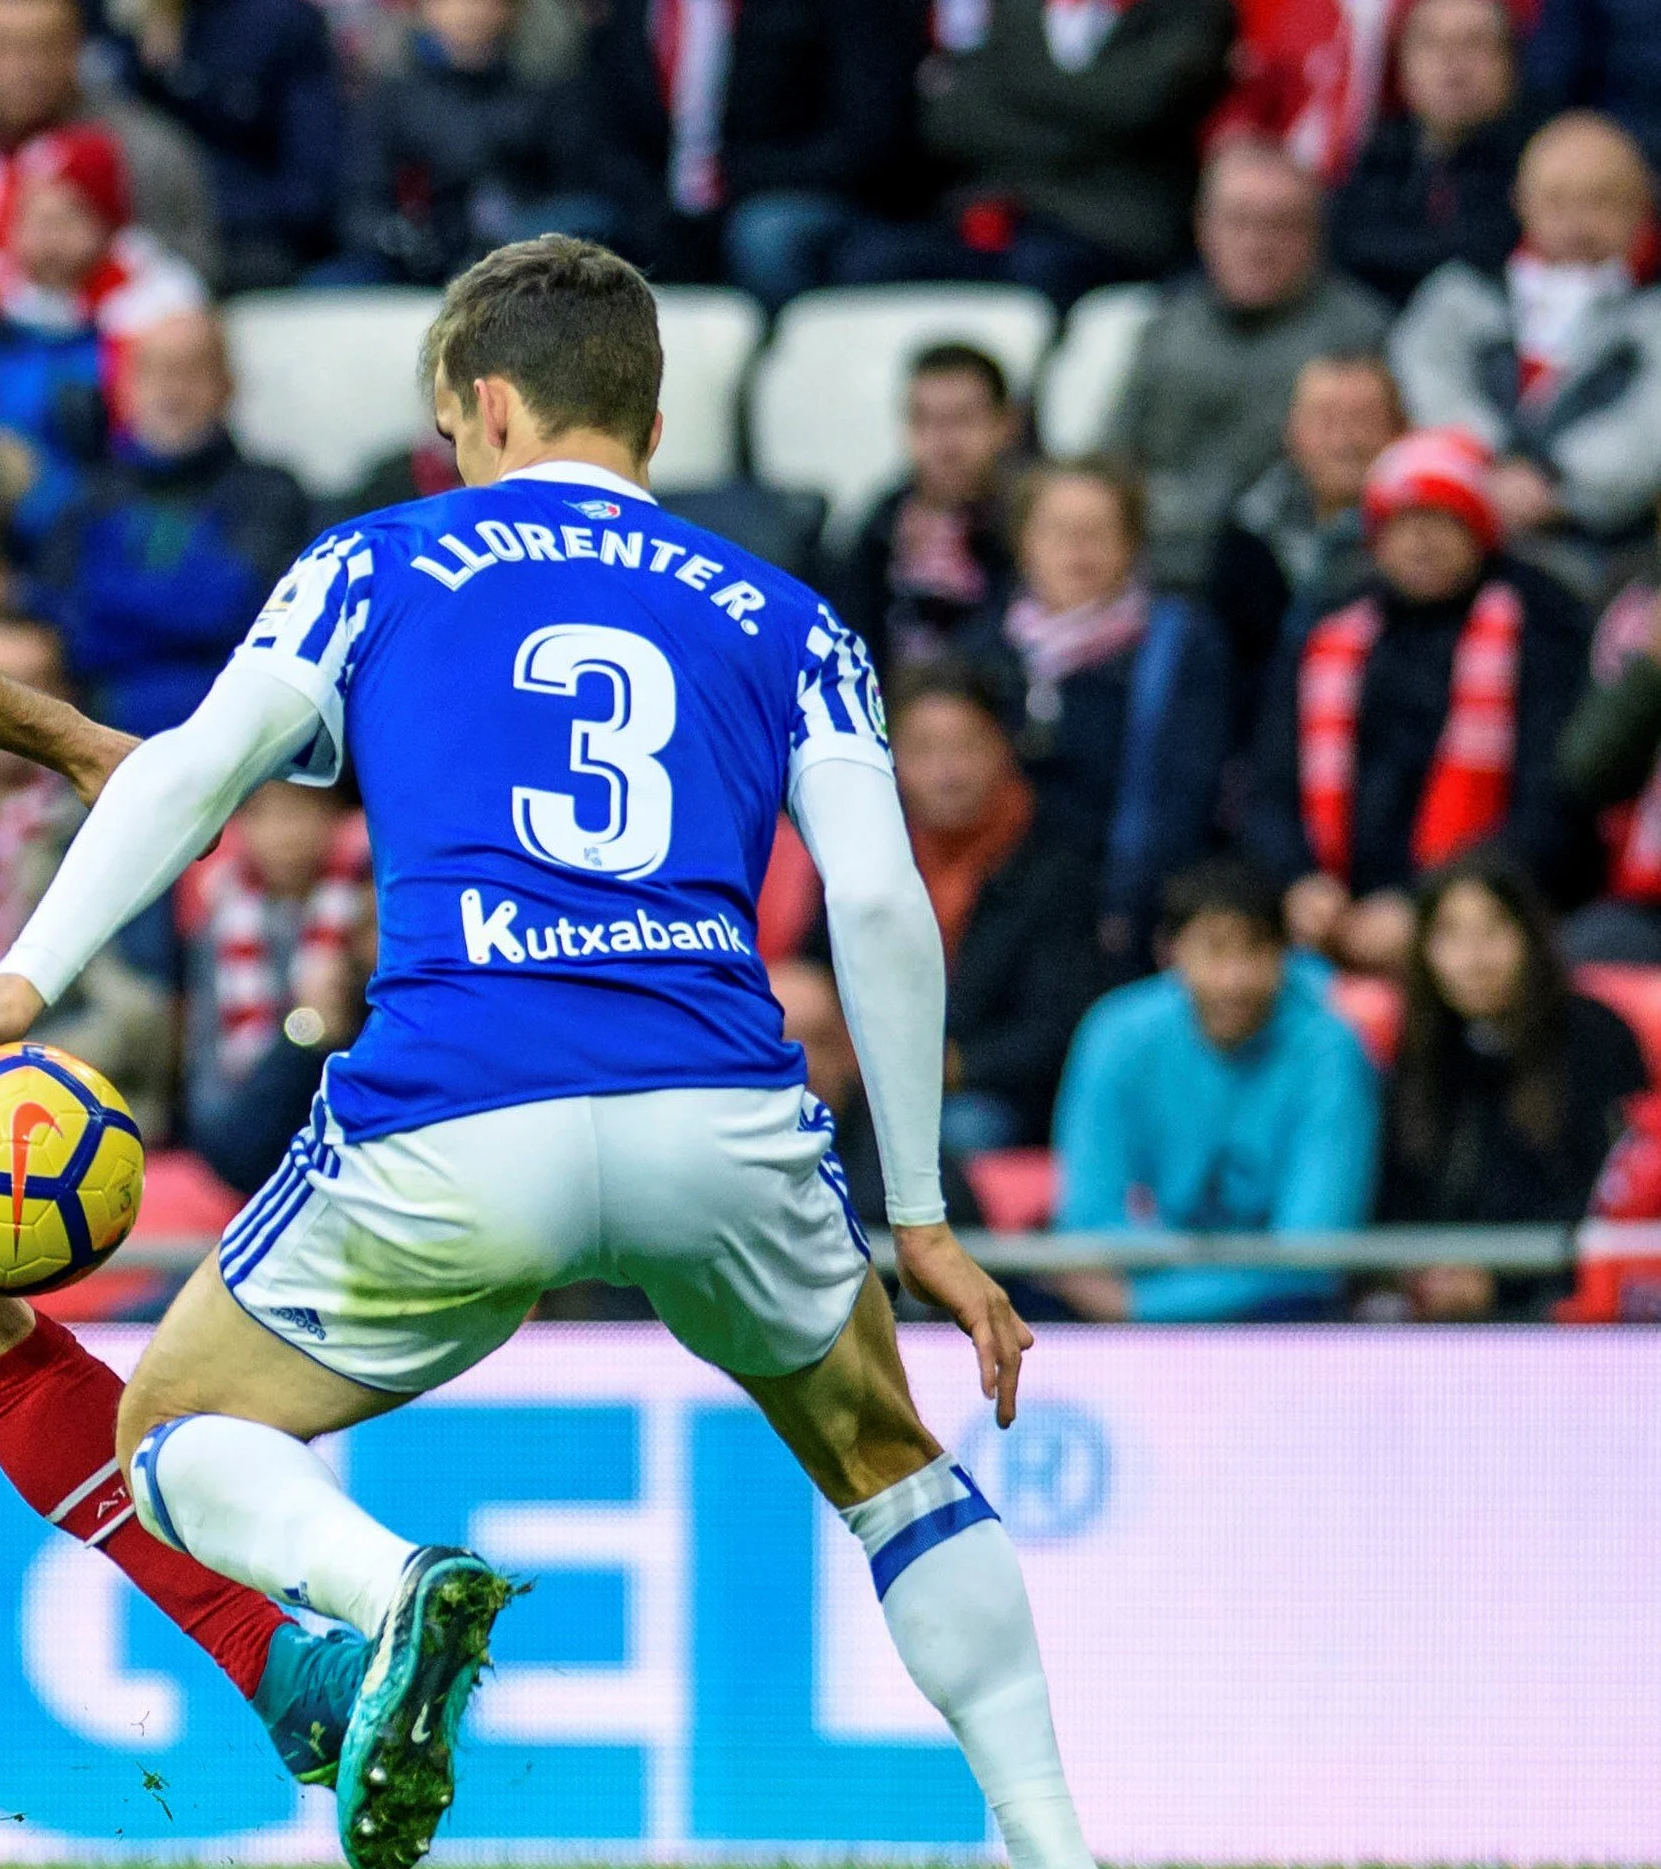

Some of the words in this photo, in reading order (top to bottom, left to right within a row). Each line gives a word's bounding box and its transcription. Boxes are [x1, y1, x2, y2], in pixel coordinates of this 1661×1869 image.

[411, 520, 725, 592] LLORENTE
[711, 579, 766, 636] R.
[511, 622, 677, 881] 3
[460, 889, 751, 966] Kutxabank
